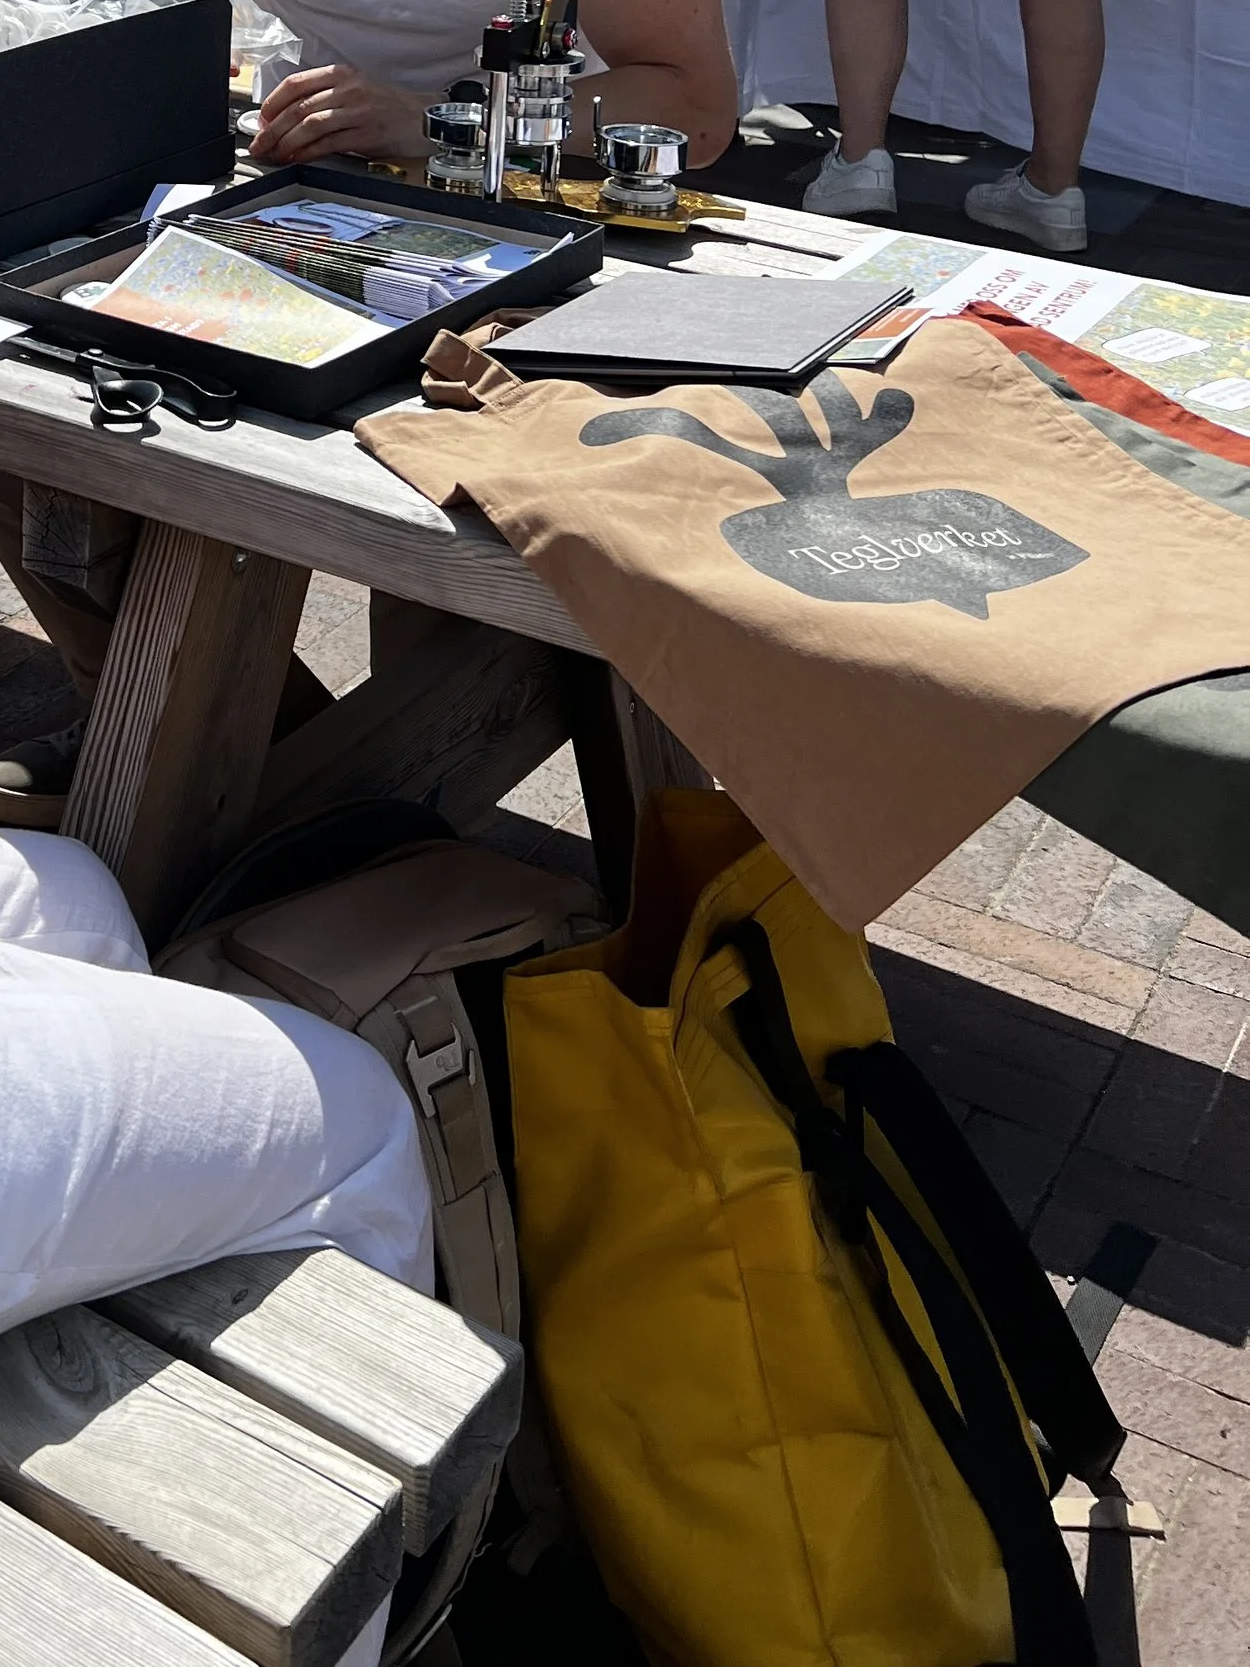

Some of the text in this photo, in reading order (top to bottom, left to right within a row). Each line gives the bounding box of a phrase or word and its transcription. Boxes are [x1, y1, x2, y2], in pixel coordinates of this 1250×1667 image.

[975, 268, 1026, 299] OSS OM
[1003, 292, 1038, 313] GEN
[788, 524, 1022, 576] Teglverket
